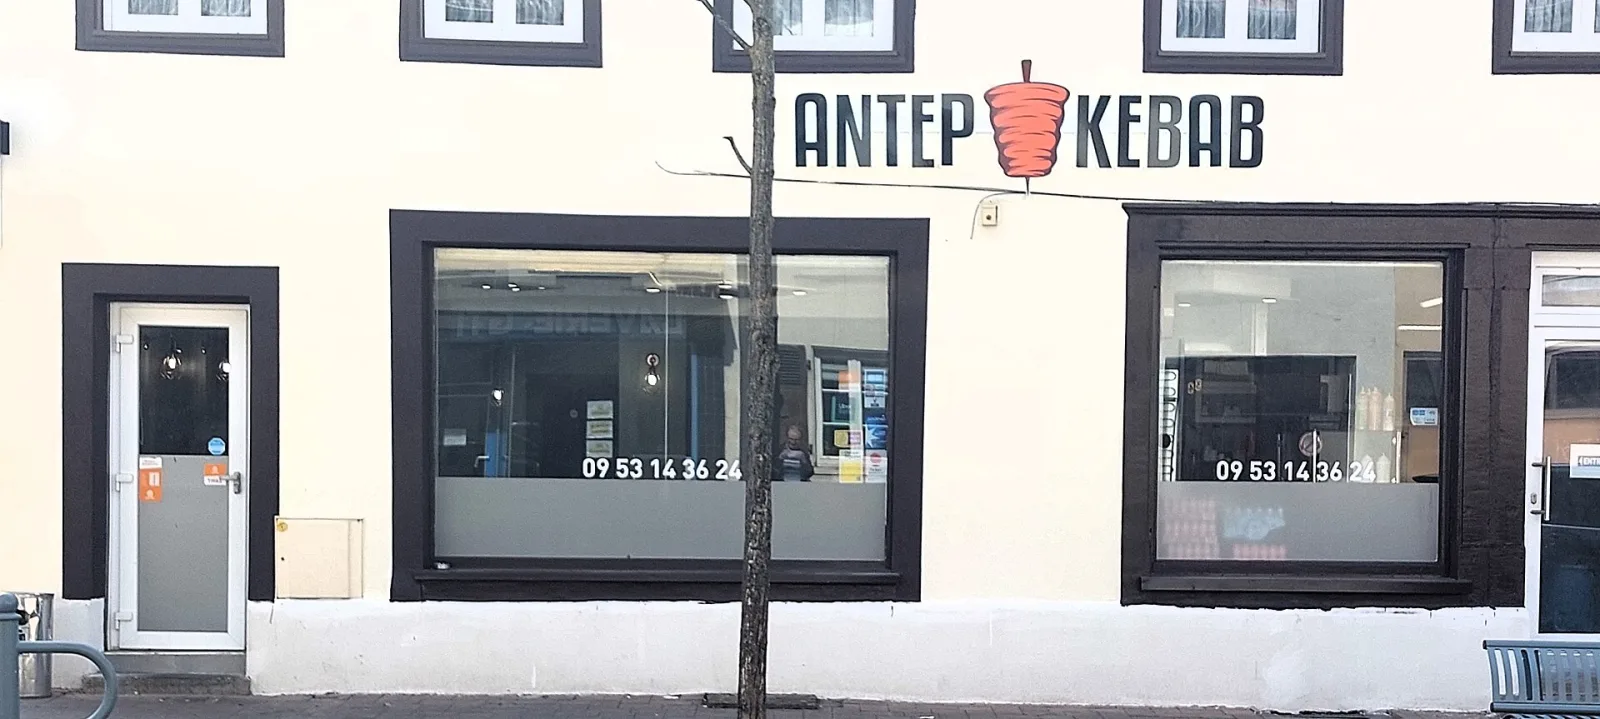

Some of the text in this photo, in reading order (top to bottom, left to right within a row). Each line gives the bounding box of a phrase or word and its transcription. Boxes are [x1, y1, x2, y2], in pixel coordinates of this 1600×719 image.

[794, 92, 1265, 169] ANTEP KEBAB
[582, 458, 742, 480] 09 53 14 36 24
[1216, 460, 1376, 482] 09 53 14 36 24
